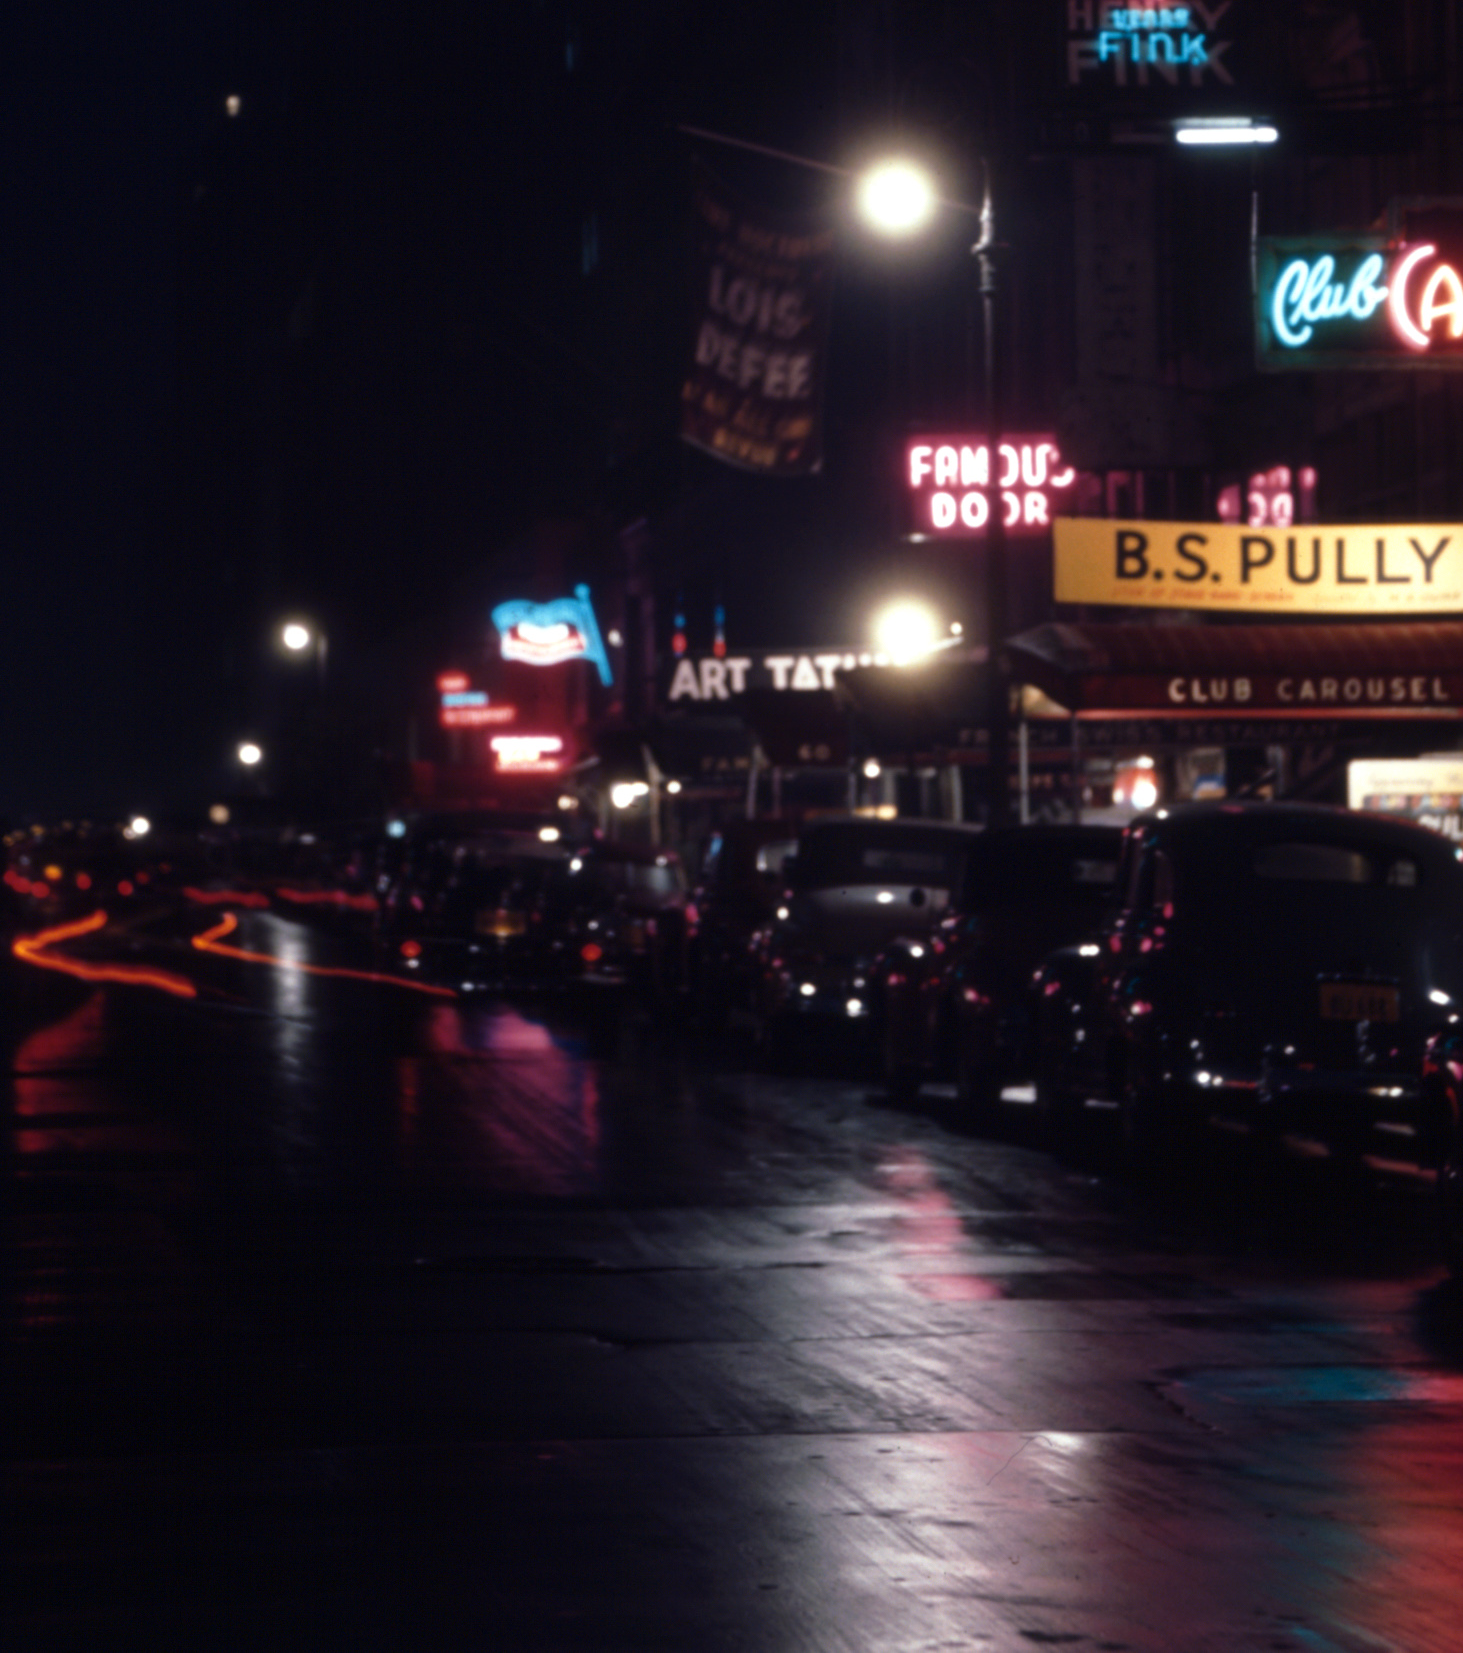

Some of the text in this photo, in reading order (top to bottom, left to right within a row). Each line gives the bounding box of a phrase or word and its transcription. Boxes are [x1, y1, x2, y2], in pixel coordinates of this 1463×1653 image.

[1272, 254, 1388, 345] Club
[1240, 536, 1452, 585] PULLY
[669, 659, 752, 700] ART
[1169, 677, 1449, 703] CLUB CAROUSEL
